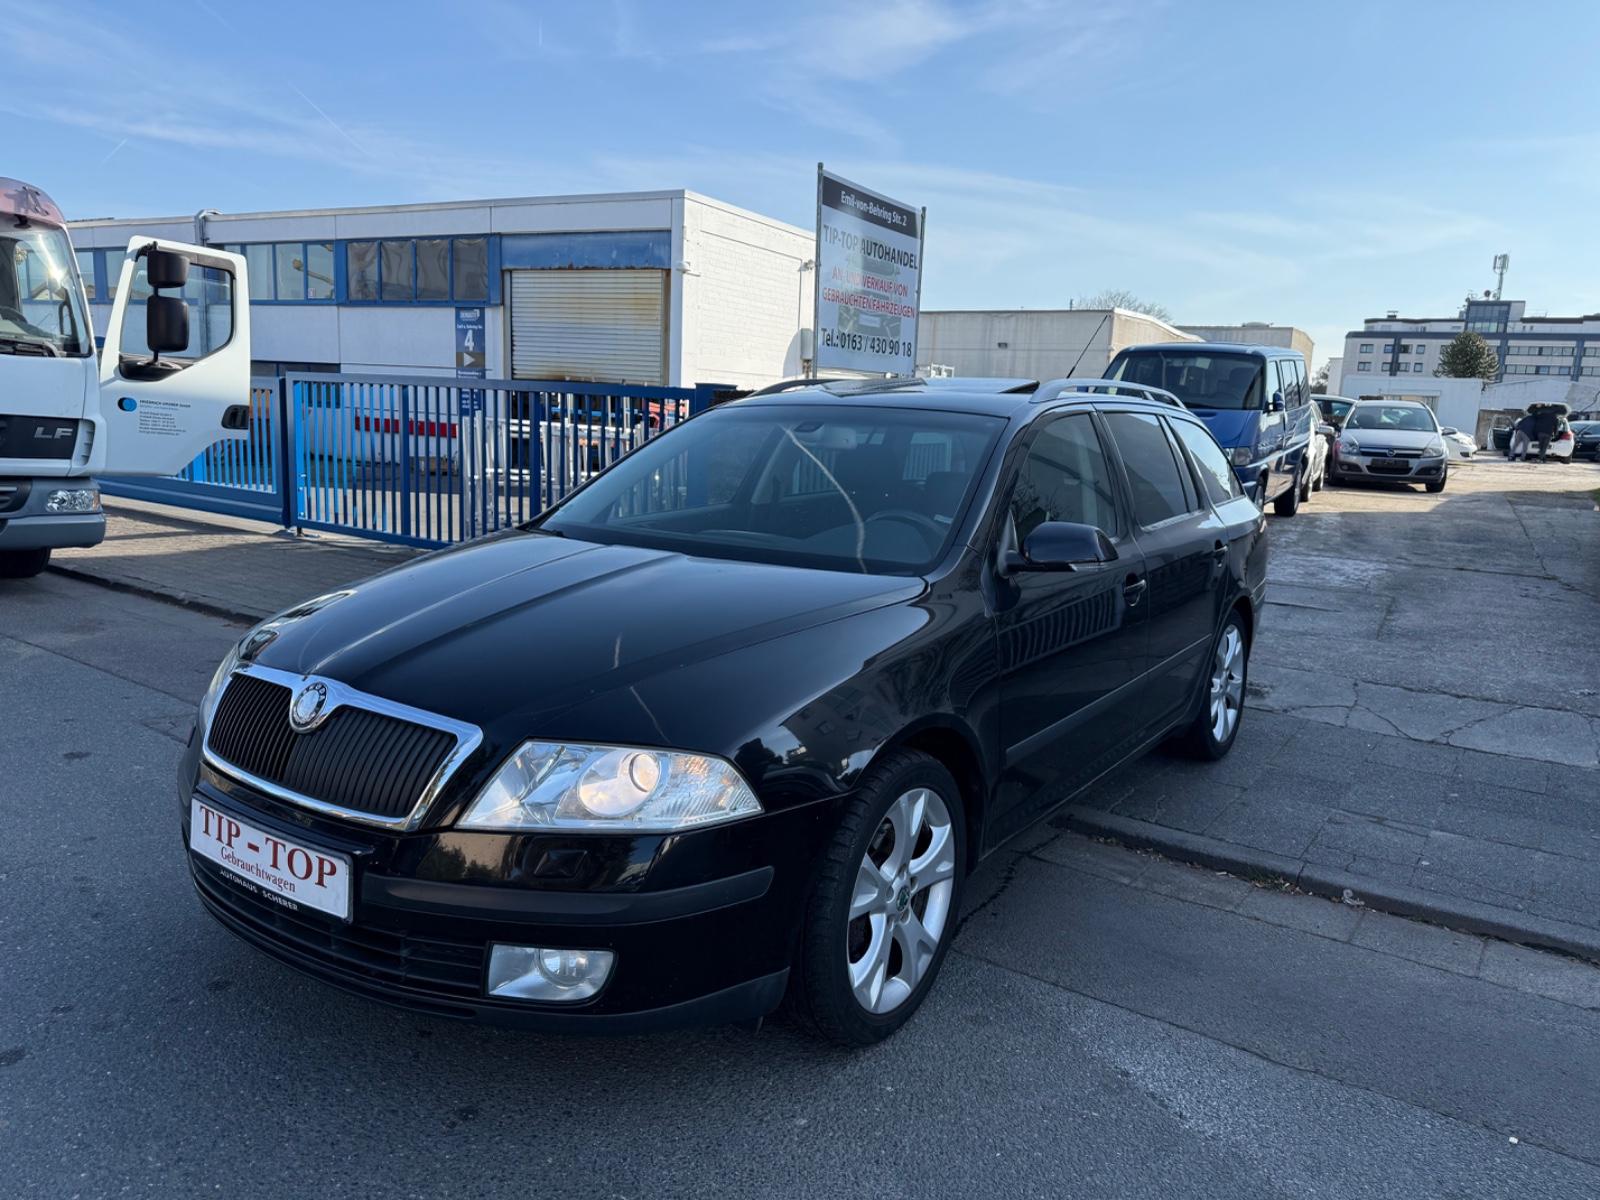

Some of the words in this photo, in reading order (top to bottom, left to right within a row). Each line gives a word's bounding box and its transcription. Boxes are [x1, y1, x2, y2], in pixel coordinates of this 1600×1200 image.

[823, 225, 859, 251] TIP-TOP
[860, 238, 918, 270] AUTOHANDEL
[862, 274, 894, 294] VERKAUF
[894, 281, 909, 297] VON
[823, 287, 871, 310] GEBRAUCHTEN
[872, 299, 915, 319] FAHRZEUGEN
[464, 329, 475, 352] 4
[821, 327, 838, 347] Tel.:
[840, 332, 863, 351] 0163
[870, 336, 887, 354] 430
[888, 338, 900, 356] 90
[902, 341, 912, 357] 18
[34, 426, 73, 439] LF
[200, 805, 241, 849] TIP
[265, 837, 337, 888] TOP
[220, 846, 296, 893] Gebrauchtwagen
[220, 869, 258, 894] AUTOHAUS
[261, 890, 299, 911] SCHERER
